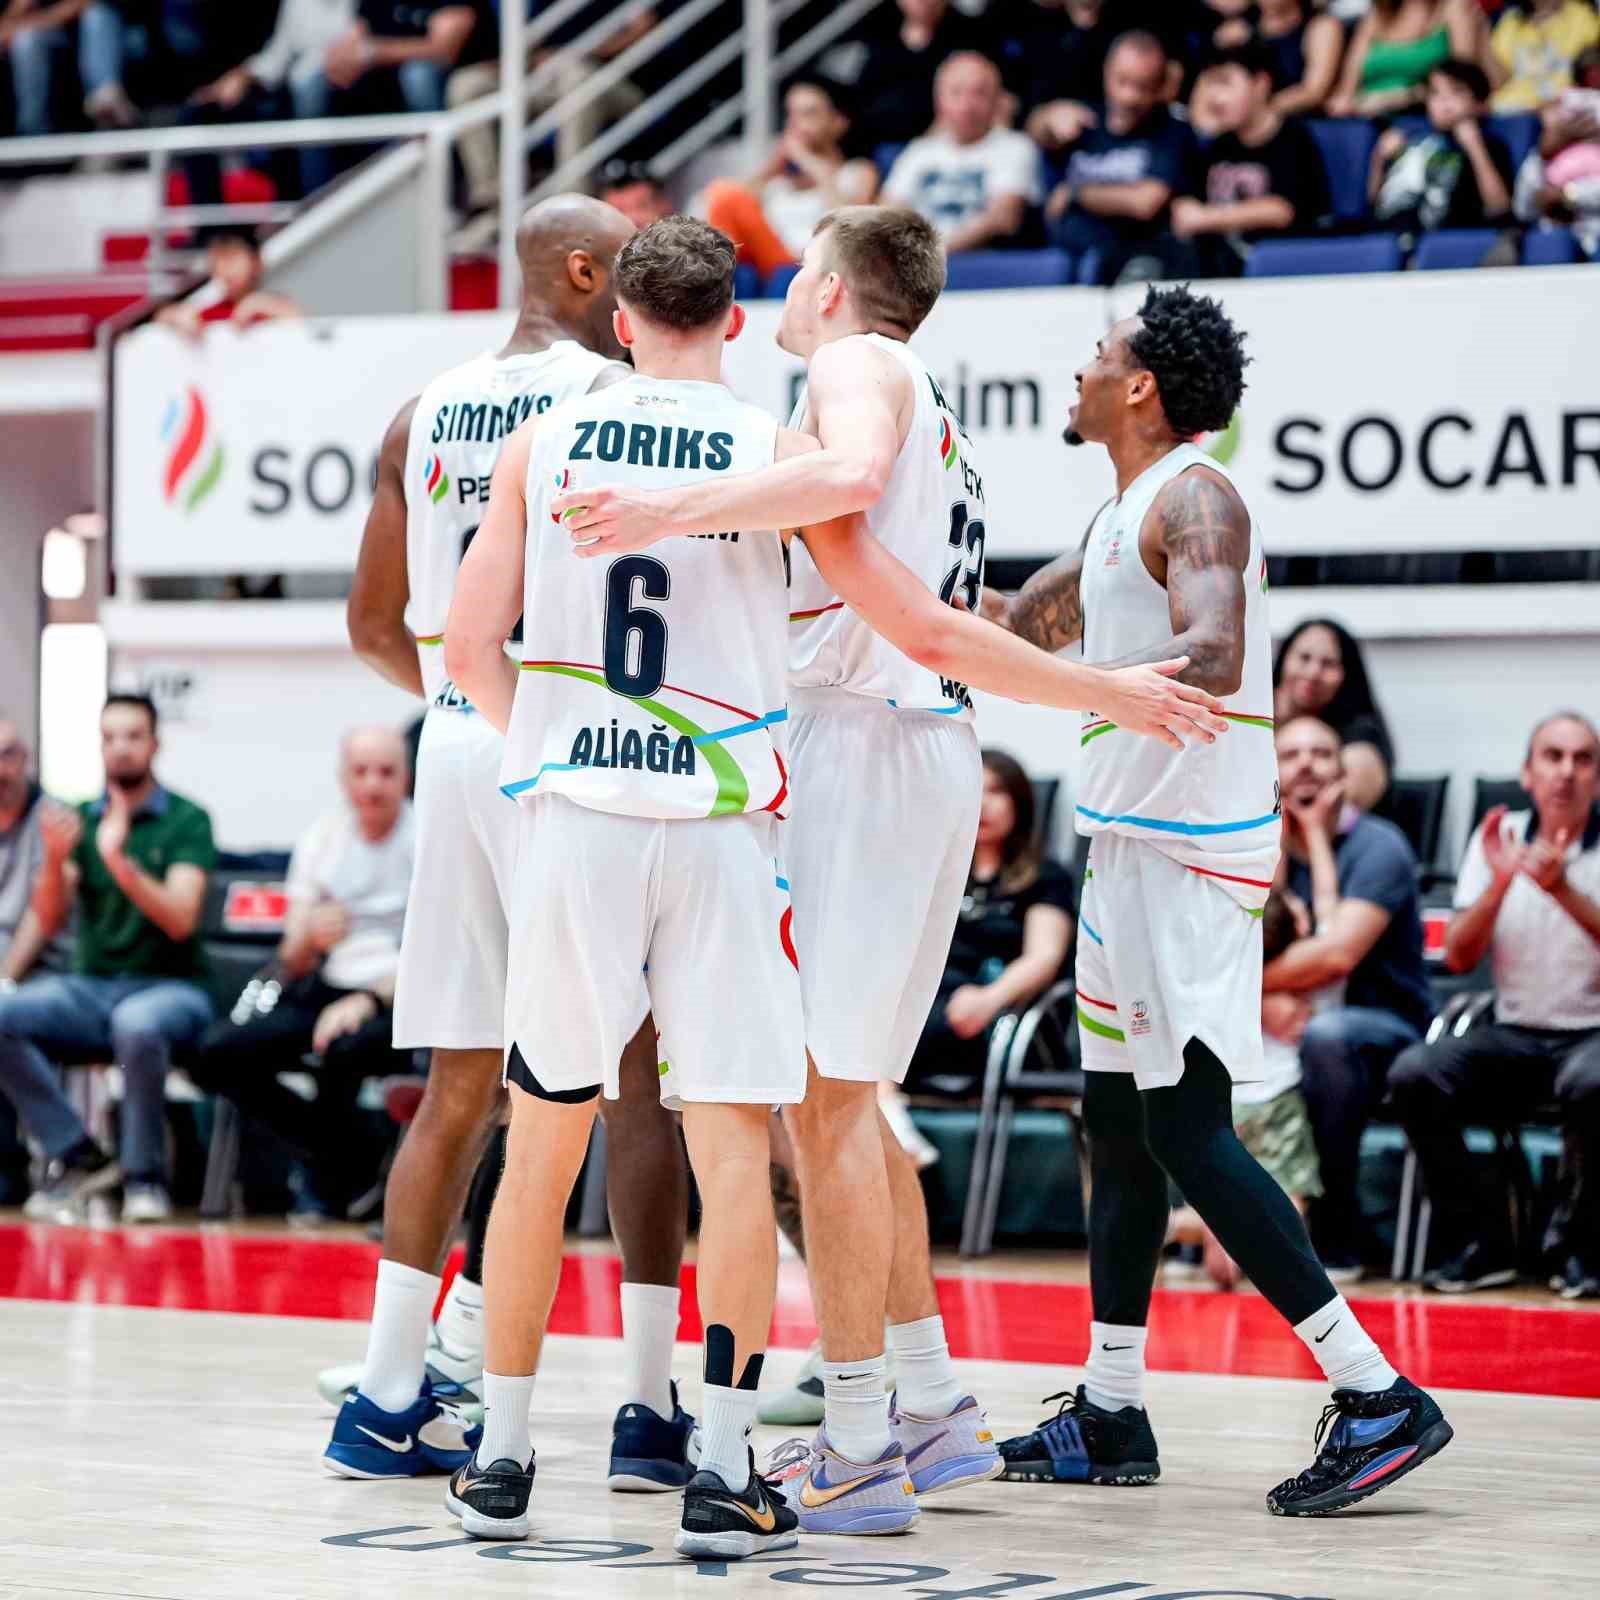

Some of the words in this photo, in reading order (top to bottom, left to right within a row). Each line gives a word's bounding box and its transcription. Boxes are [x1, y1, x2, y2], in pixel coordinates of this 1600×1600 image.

[568, 420, 734, 471] ZORIKS
[1272, 410, 1600, 493] SOCAR
[250, 446, 380, 515] SO
[603, 555, 671, 699] 6
[569, 720, 696, 776] ALİAĞA
